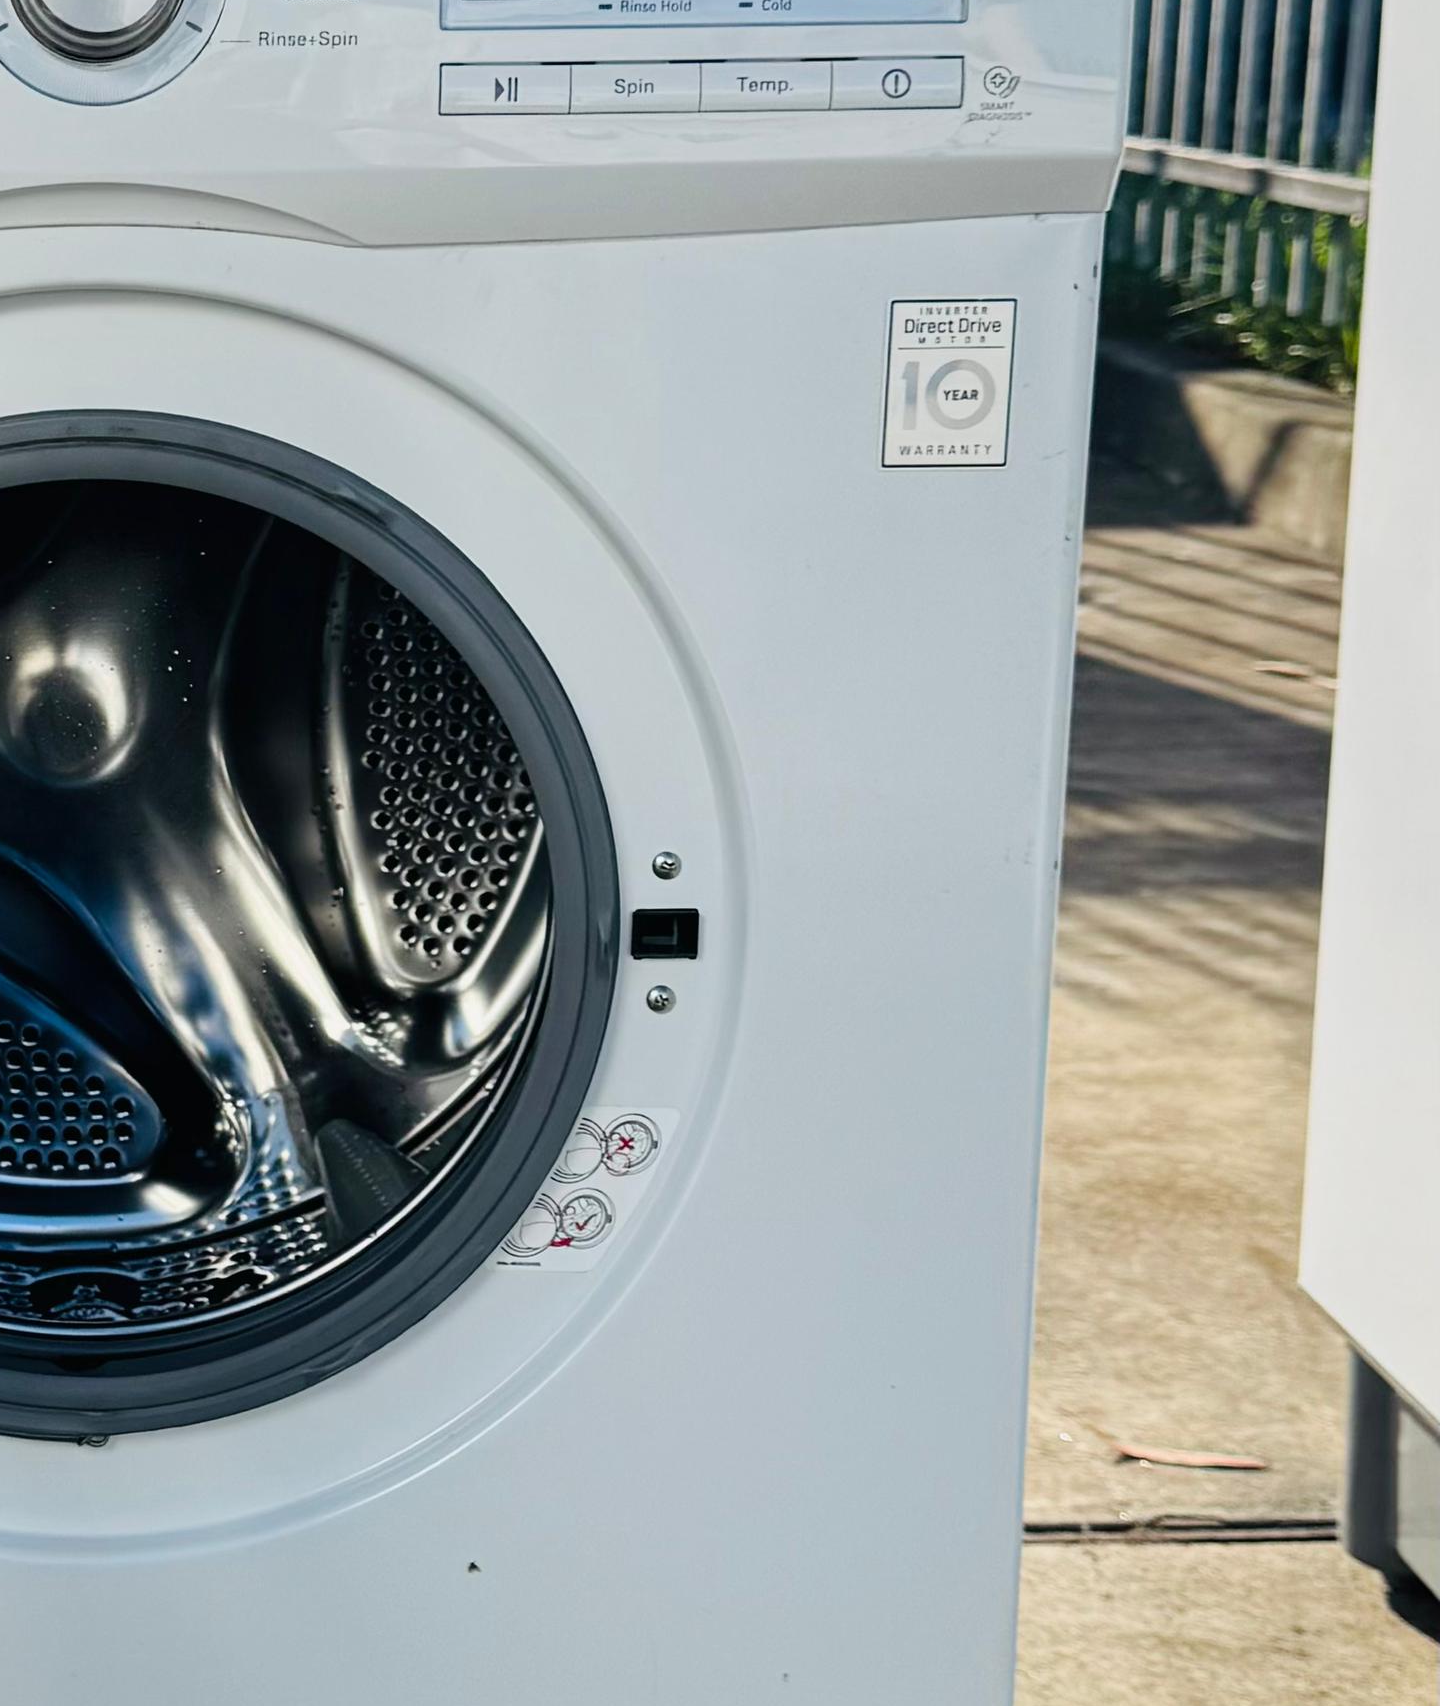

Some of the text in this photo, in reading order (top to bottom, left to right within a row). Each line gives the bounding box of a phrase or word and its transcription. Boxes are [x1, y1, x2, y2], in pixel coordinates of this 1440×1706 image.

[620, 1, 692, 12] Rinse Hold
[762, 0, 792, 11] Cold
[257, 32, 358, 50] Rinse+Spin
[614, 78, 655, 98] Spin
[736, 75, 794, 96] Temp.
[919, 307, 989, 315] INVERTER
[904, 318, 1002, 333] Direct Drive
[902, 359, 996, 430] 10
[943, 390, 979, 400] YEAR
[899, 444, 992, 456] WARRANTY
